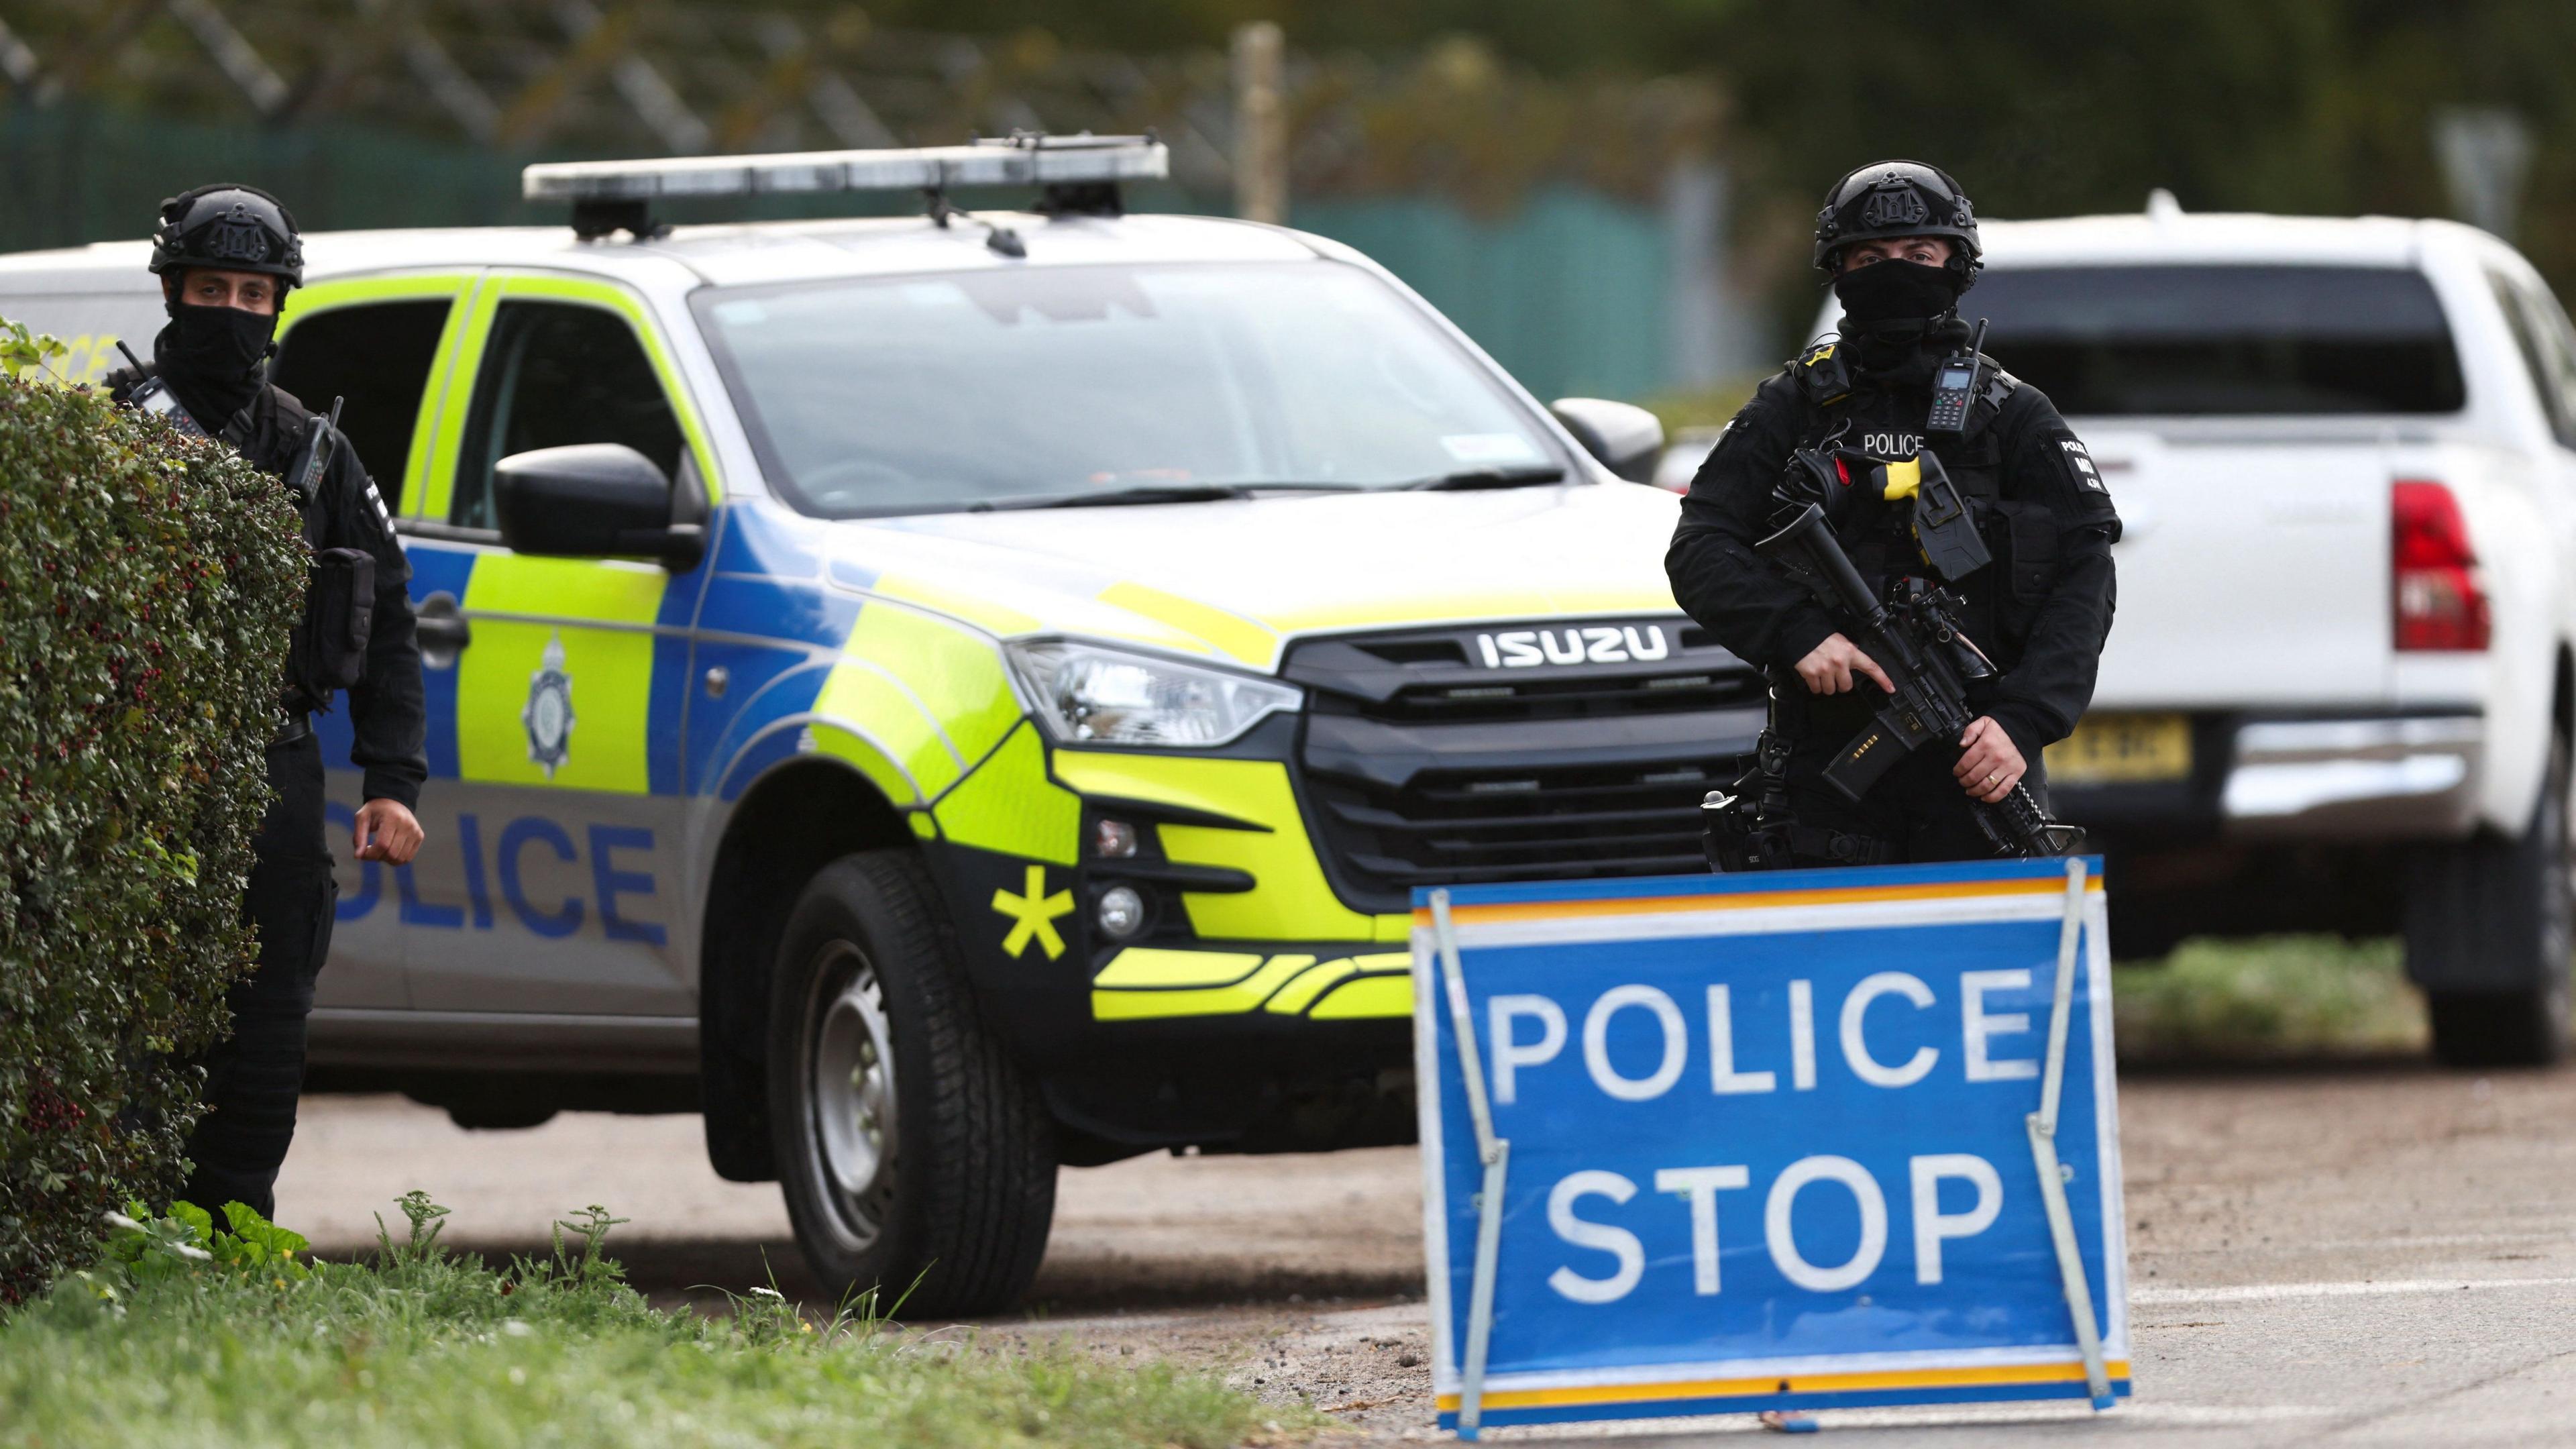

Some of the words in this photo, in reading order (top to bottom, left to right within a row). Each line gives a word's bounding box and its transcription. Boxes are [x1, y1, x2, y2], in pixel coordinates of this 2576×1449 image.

[1865, 434, 1923, 455] POLICE
[1477, 625, 1668, 669] ISUZU
[1489, 970, 2039, 1104] POLICE
[1548, 1155, 2003, 1303] STOP
